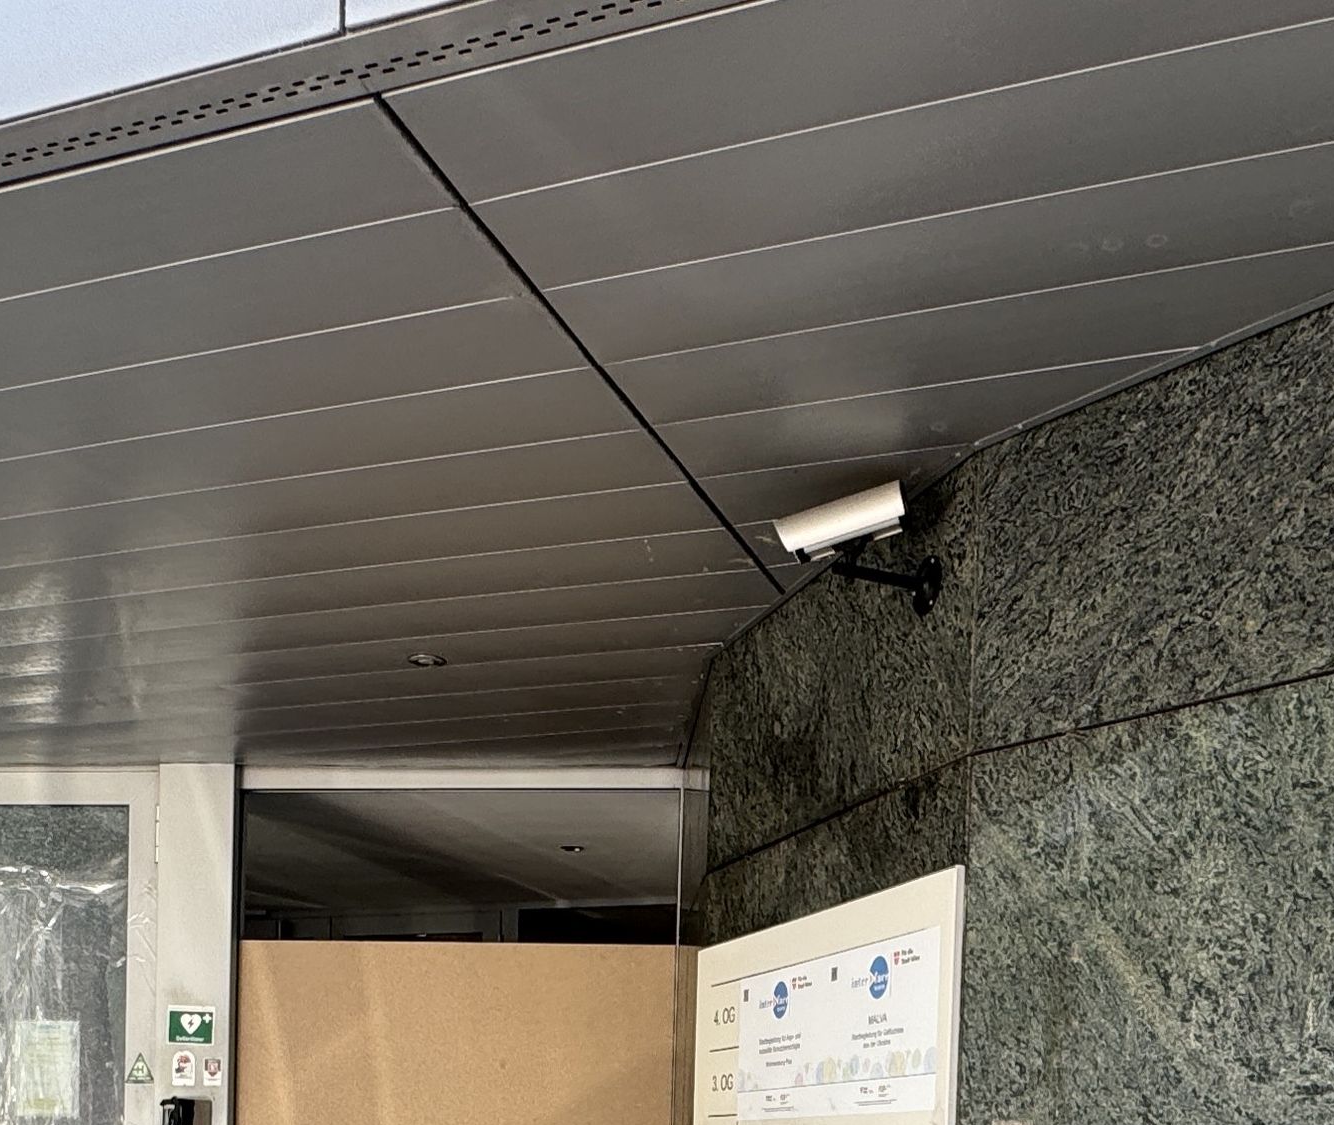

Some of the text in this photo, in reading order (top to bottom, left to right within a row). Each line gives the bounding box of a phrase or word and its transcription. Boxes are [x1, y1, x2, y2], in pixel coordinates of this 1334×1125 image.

[713, 1006, 736, 1026] 4. OG
[712, 1073, 734, 1093] 3. OG
